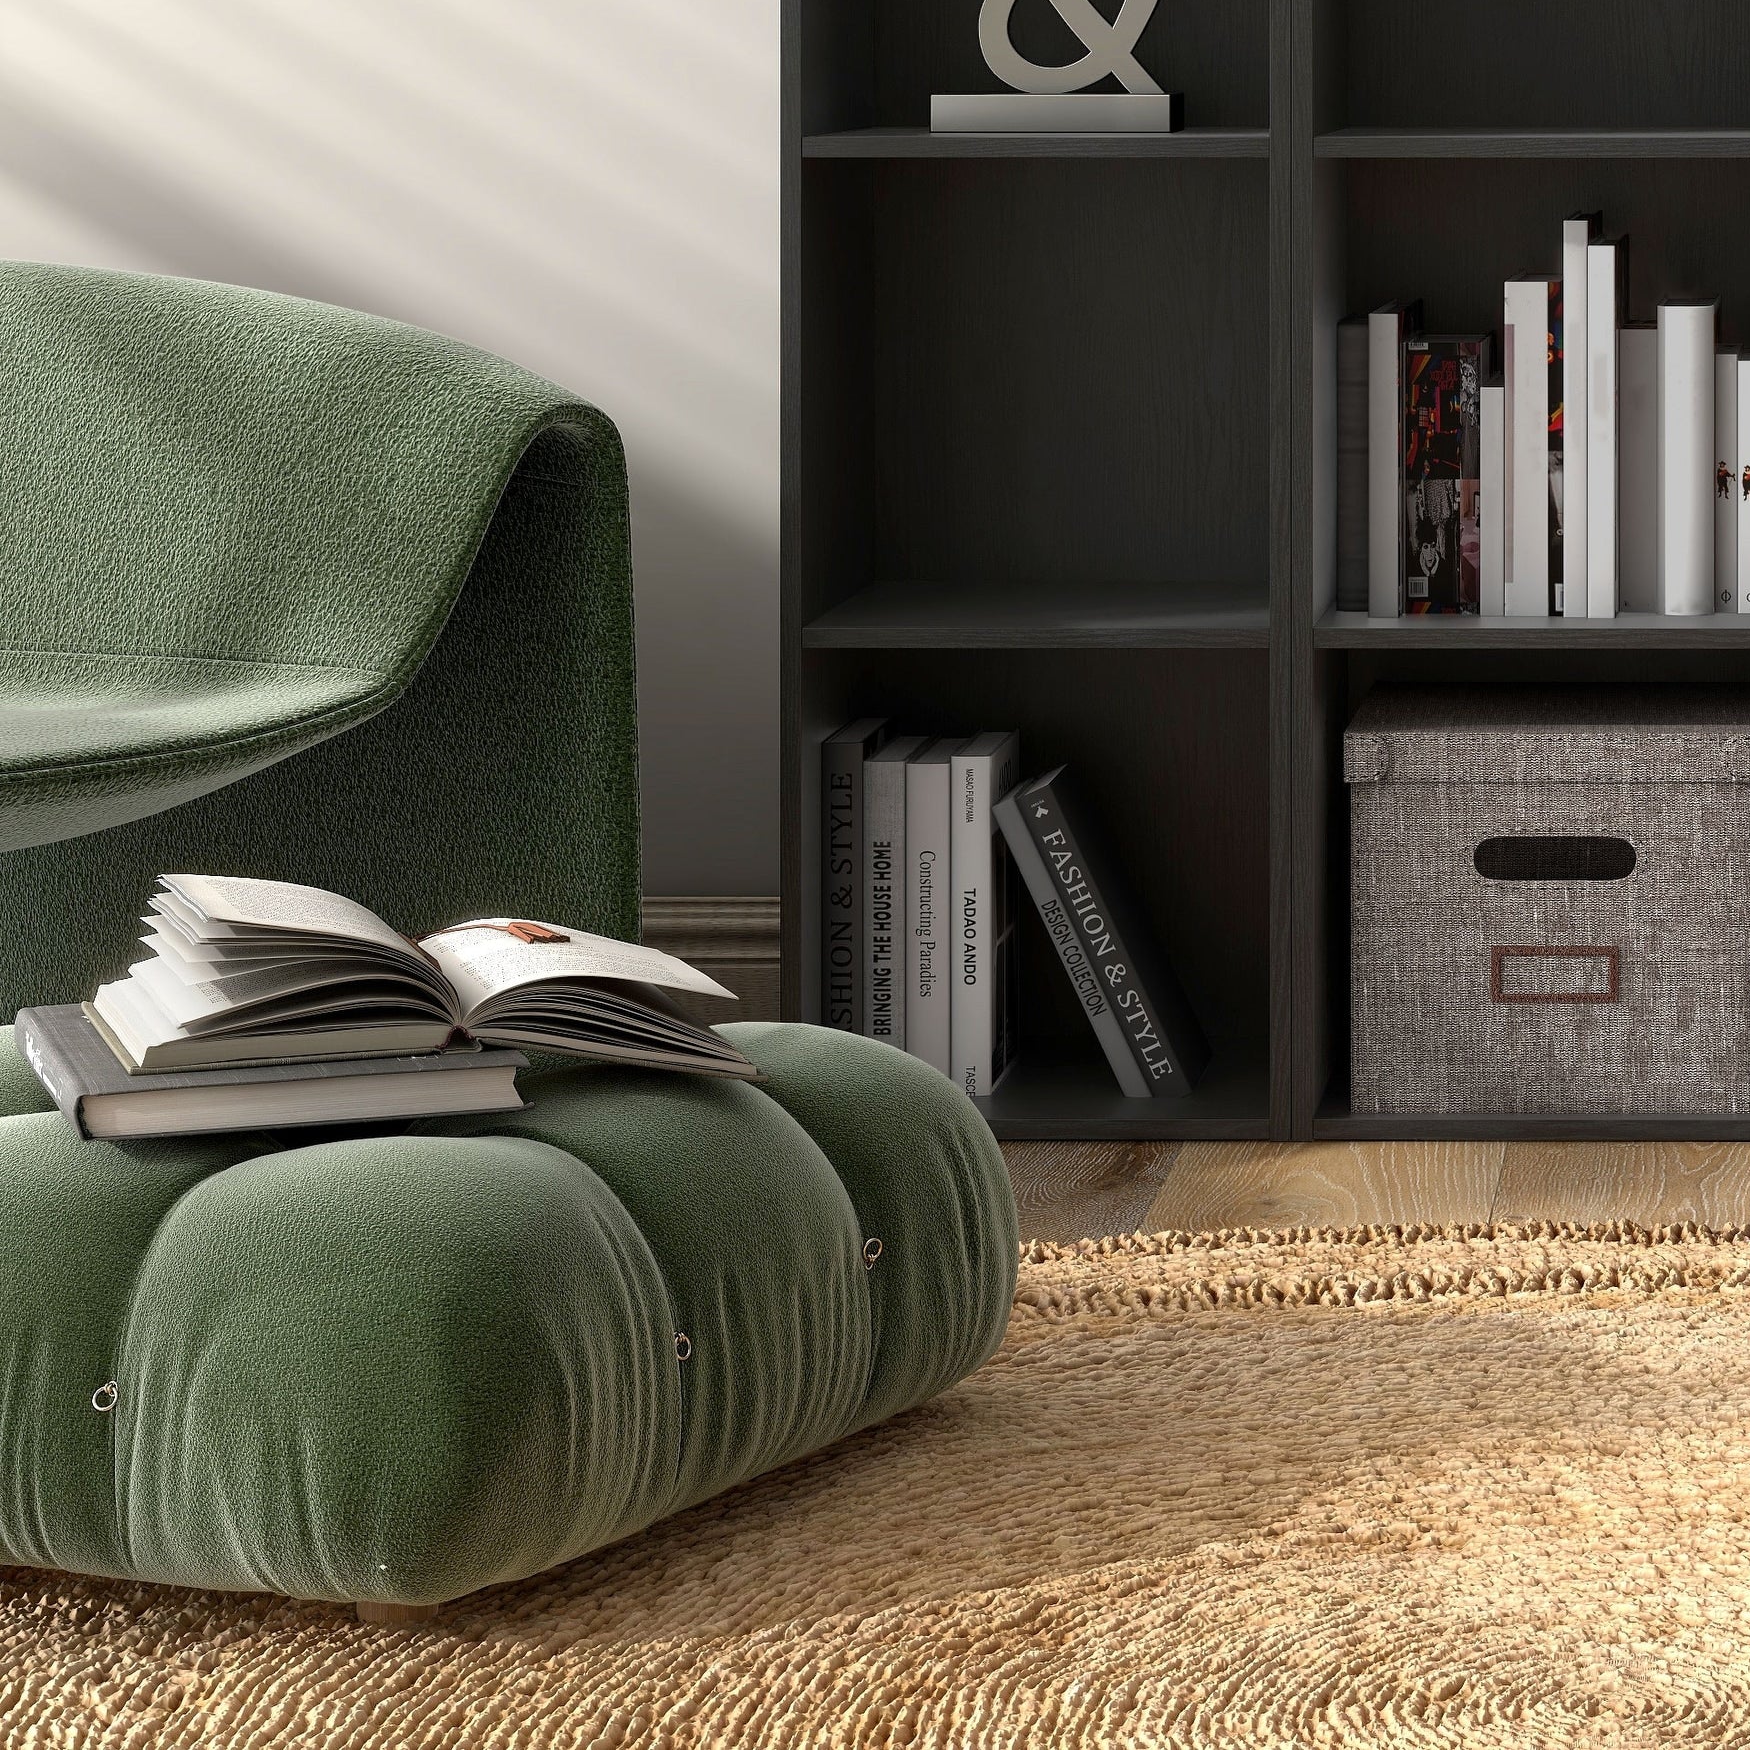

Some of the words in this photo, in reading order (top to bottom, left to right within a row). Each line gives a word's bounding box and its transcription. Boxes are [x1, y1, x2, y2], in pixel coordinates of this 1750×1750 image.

[966, 768, 974, 790] MASAO
[831, 773, 852, 875] STYLE
[873, 842, 891, 880] HOME
[831, 884, 852, 910] &
[873, 886, 891, 931] HOUSE
[916, 850, 936, 937] Constructing
[963, 888, 976, 940] TADAO
[873, 936, 891, 962] THE
[919, 940, 936, 997] Paradies
[963, 943, 976, 986] ANDO
[1041, 899, 1071, 945] DESIGN
[1062, 945, 1107, 1017] COLLECTION
[1042, 829, 1116, 955] FASHION
[1105, 964, 1126, 988] &
[1116, 990, 1172, 1080] STYLE
[831, 922, 852, 1032] SHION
[873, 968, 891, 1036] BRINGING
[966, 1066, 975, 1097] TASCE
